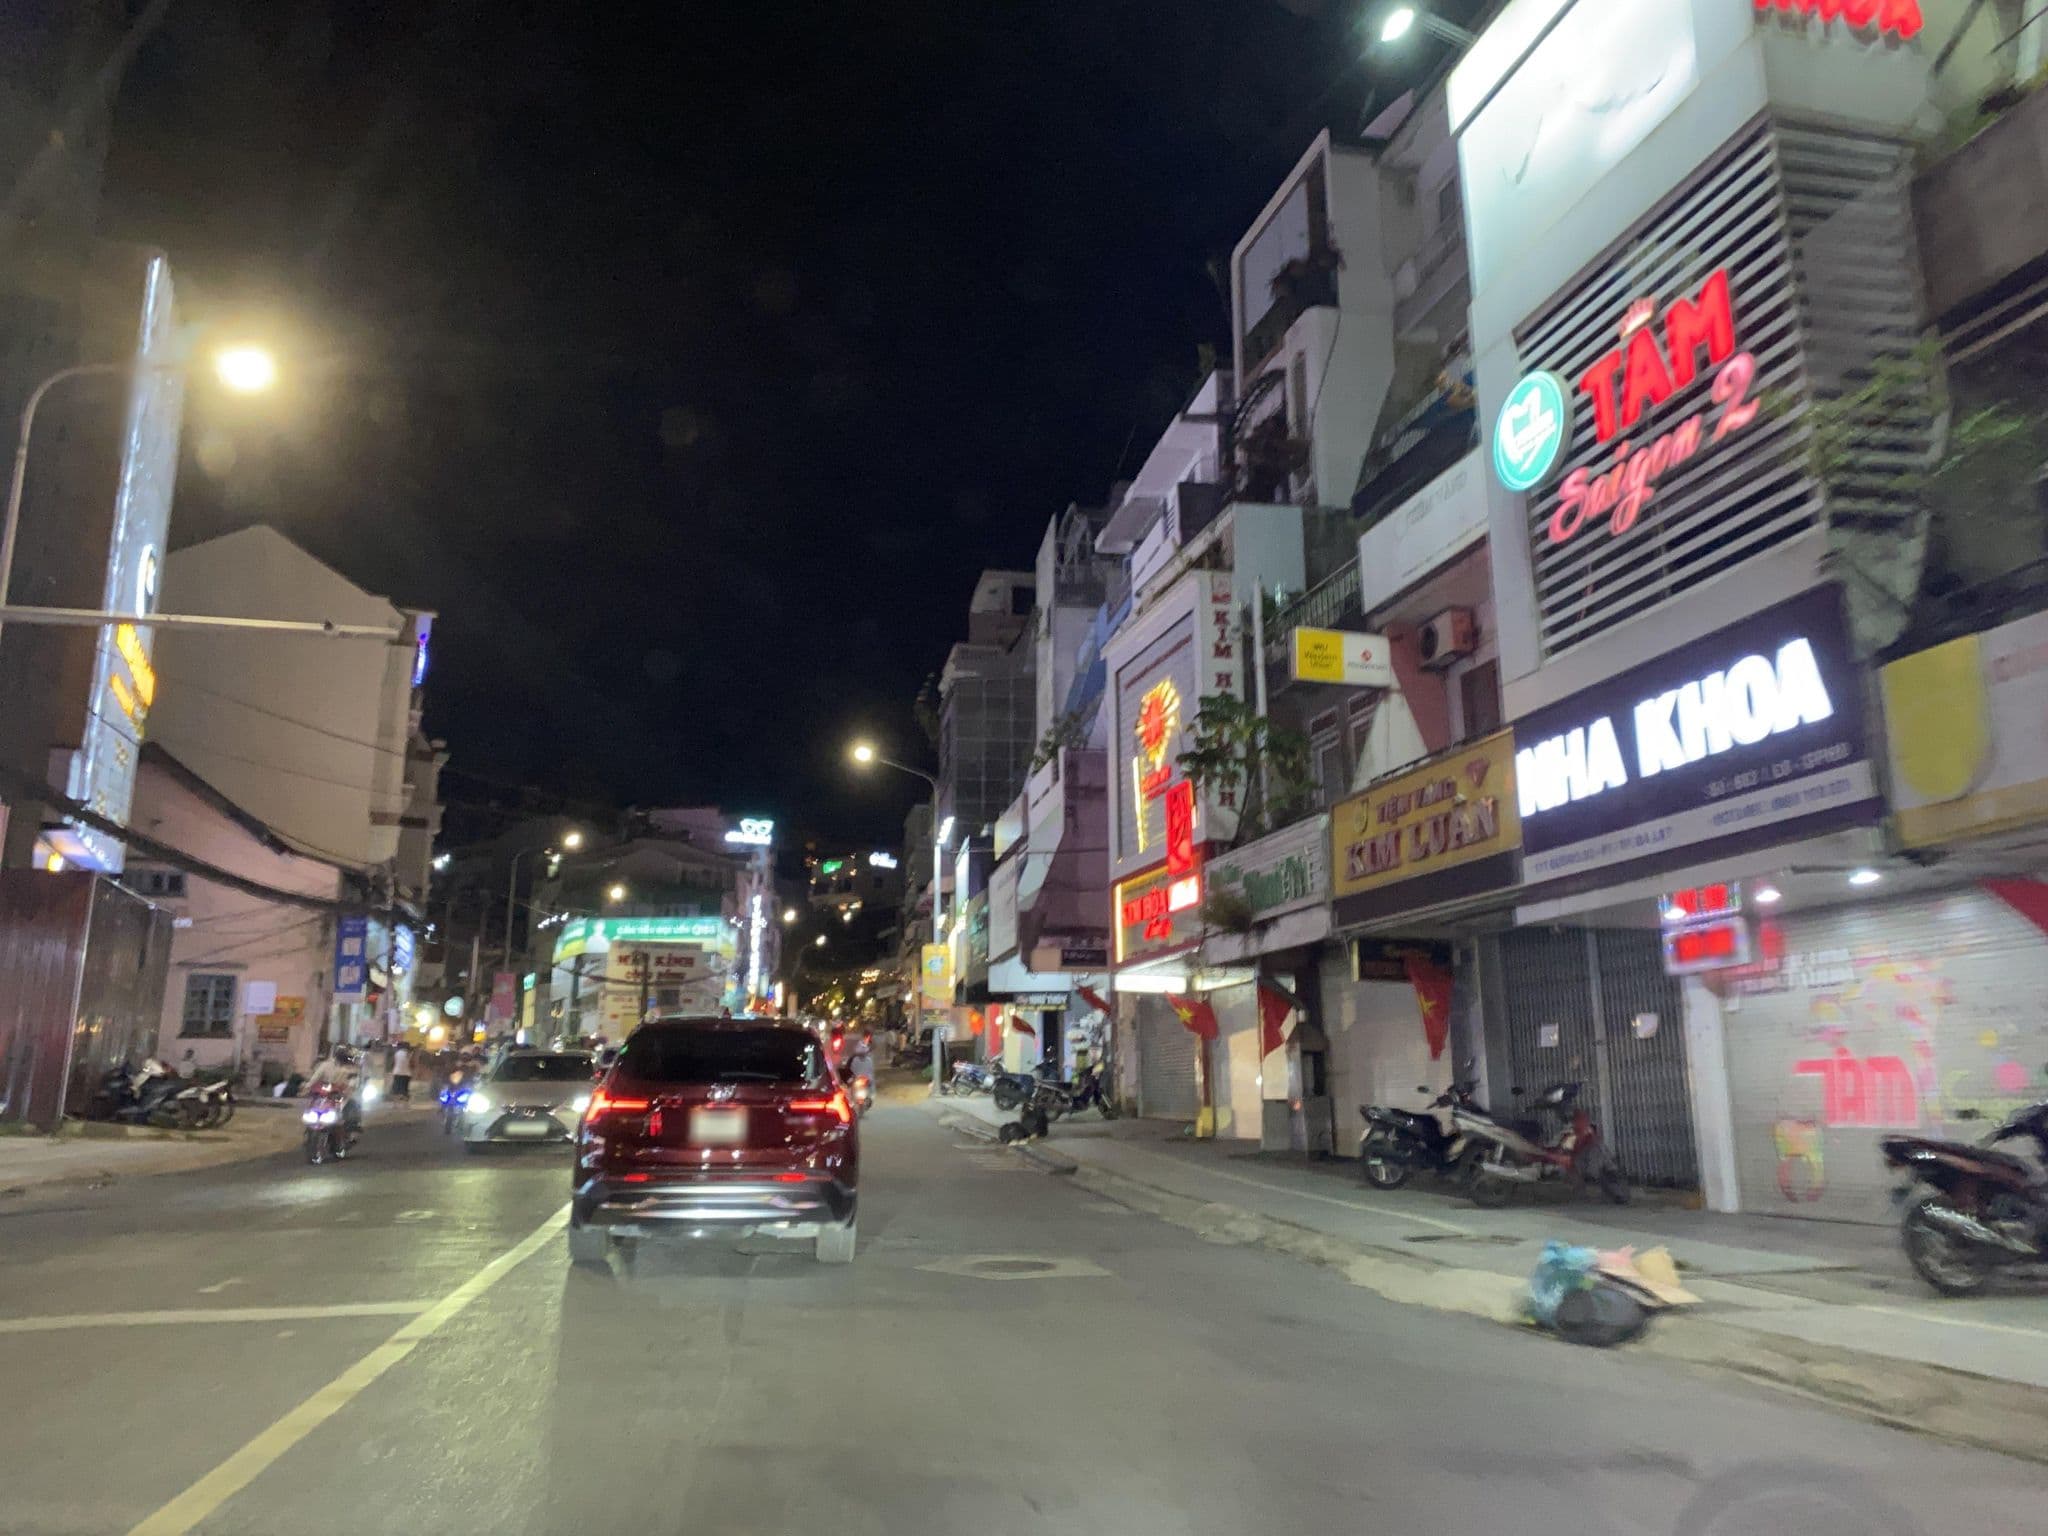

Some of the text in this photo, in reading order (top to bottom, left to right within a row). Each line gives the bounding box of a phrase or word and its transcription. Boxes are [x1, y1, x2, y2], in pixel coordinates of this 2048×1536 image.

[1711, 351, 1760, 442] 2
[1515, 716, 1628, 818] NHA
[1634, 637, 1835, 778] KHOA
[1345, 828, 1402, 881] KIM
